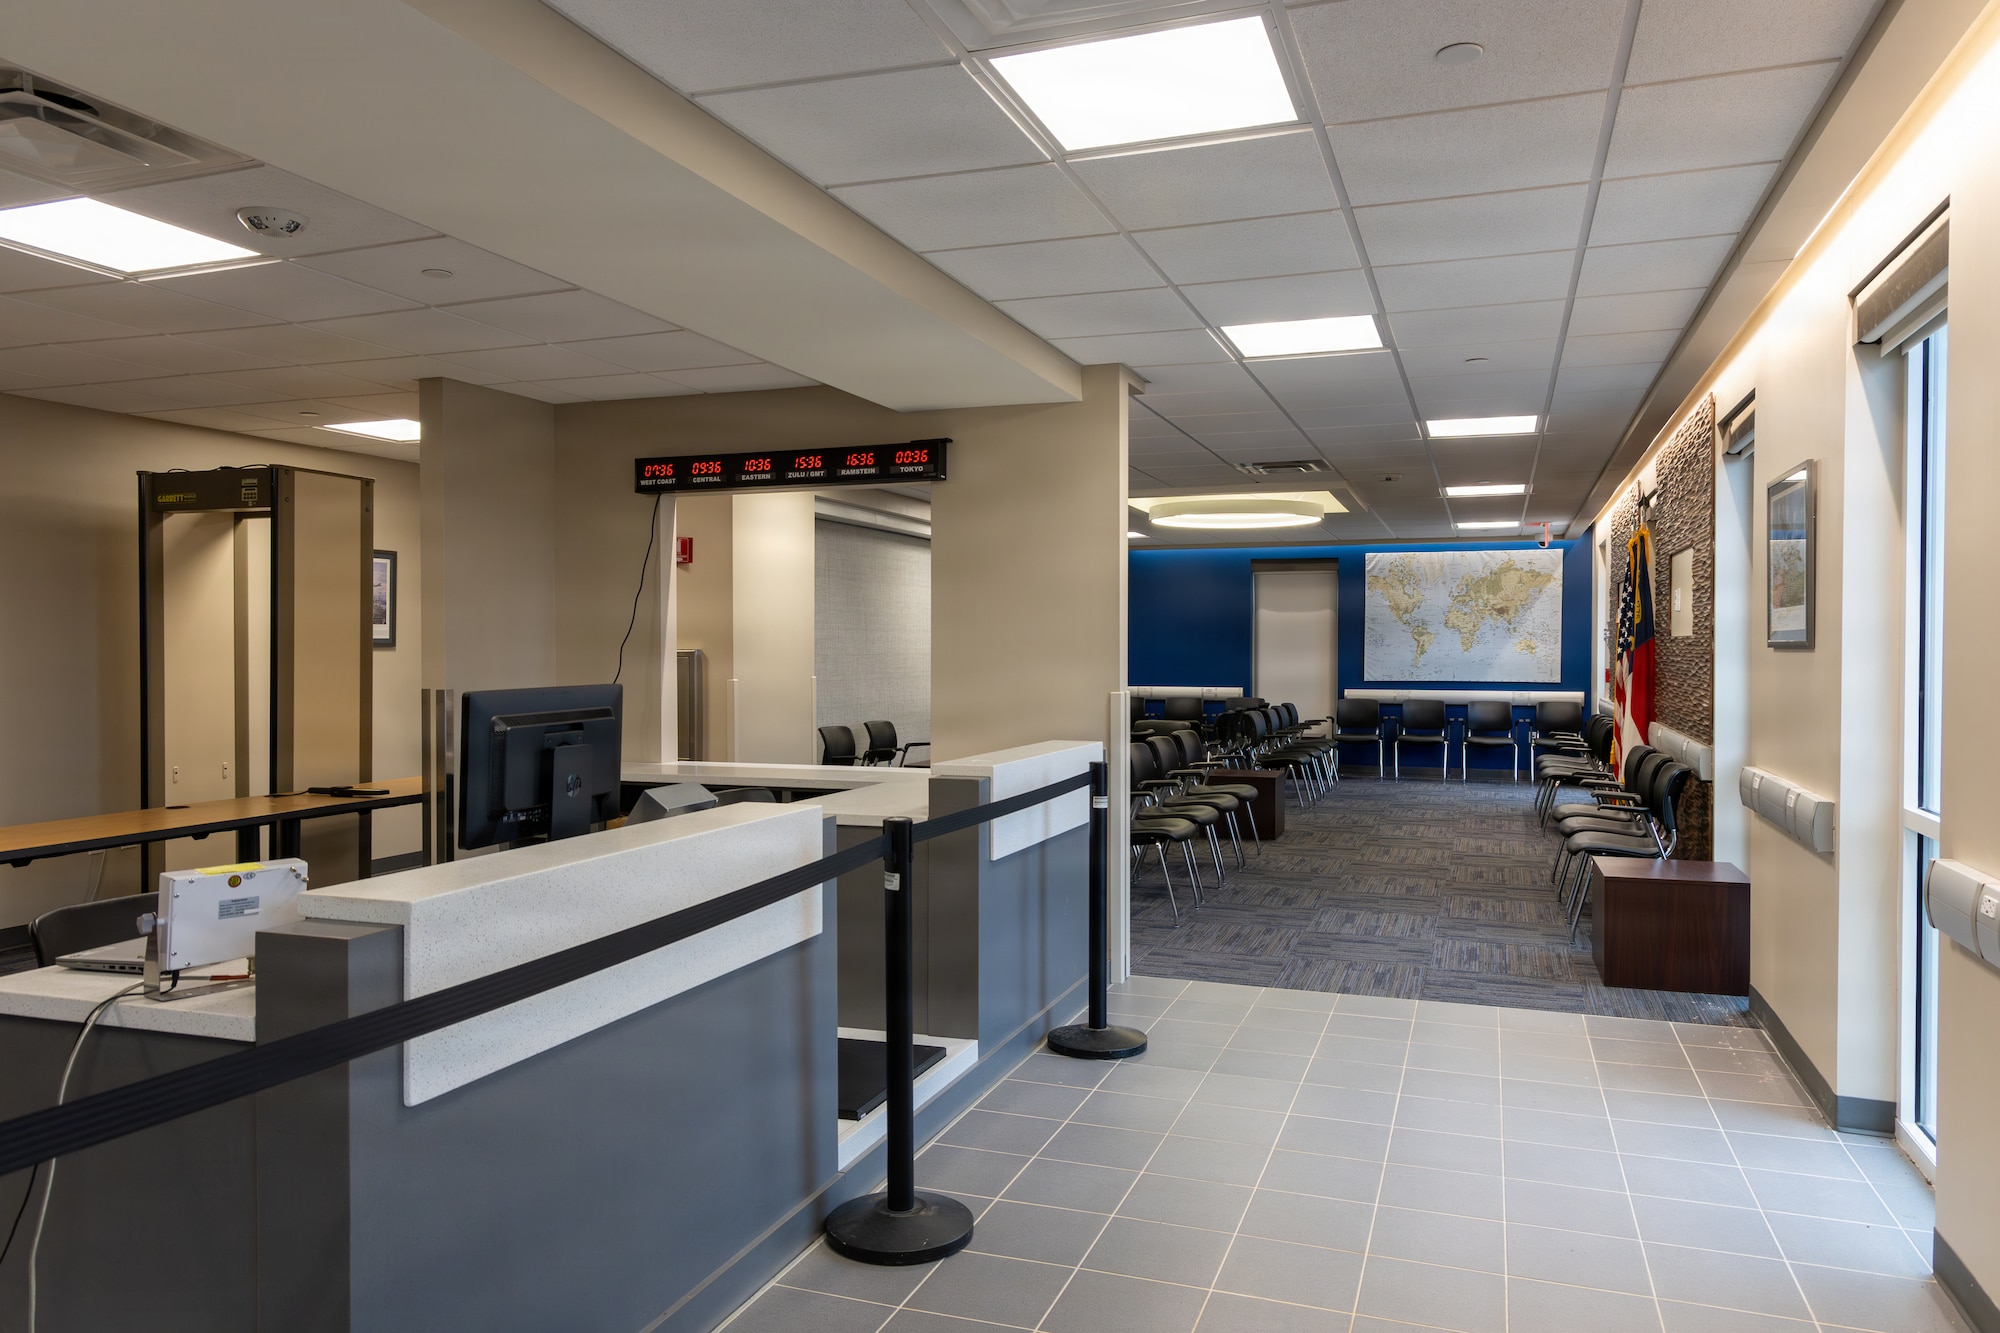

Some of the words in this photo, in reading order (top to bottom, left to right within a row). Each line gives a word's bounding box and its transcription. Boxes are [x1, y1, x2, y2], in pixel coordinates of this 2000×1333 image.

[795, 456, 822, 469] 15:36
[847, 453, 874, 466] 16:36
[895, 450, 928, 464] 00:36
[644, 464, 673, 477] 07:36
[692, 462, 721, 475] 09:36
[744, 459, 771, 471] 10:36
[899, 465, 924, 473] TOKYO
[741, 473, 771, 481] EASTERN
[841, 468, 876, 476] RAMSTEIN
[157, 494, 184, 503] GARRETT
